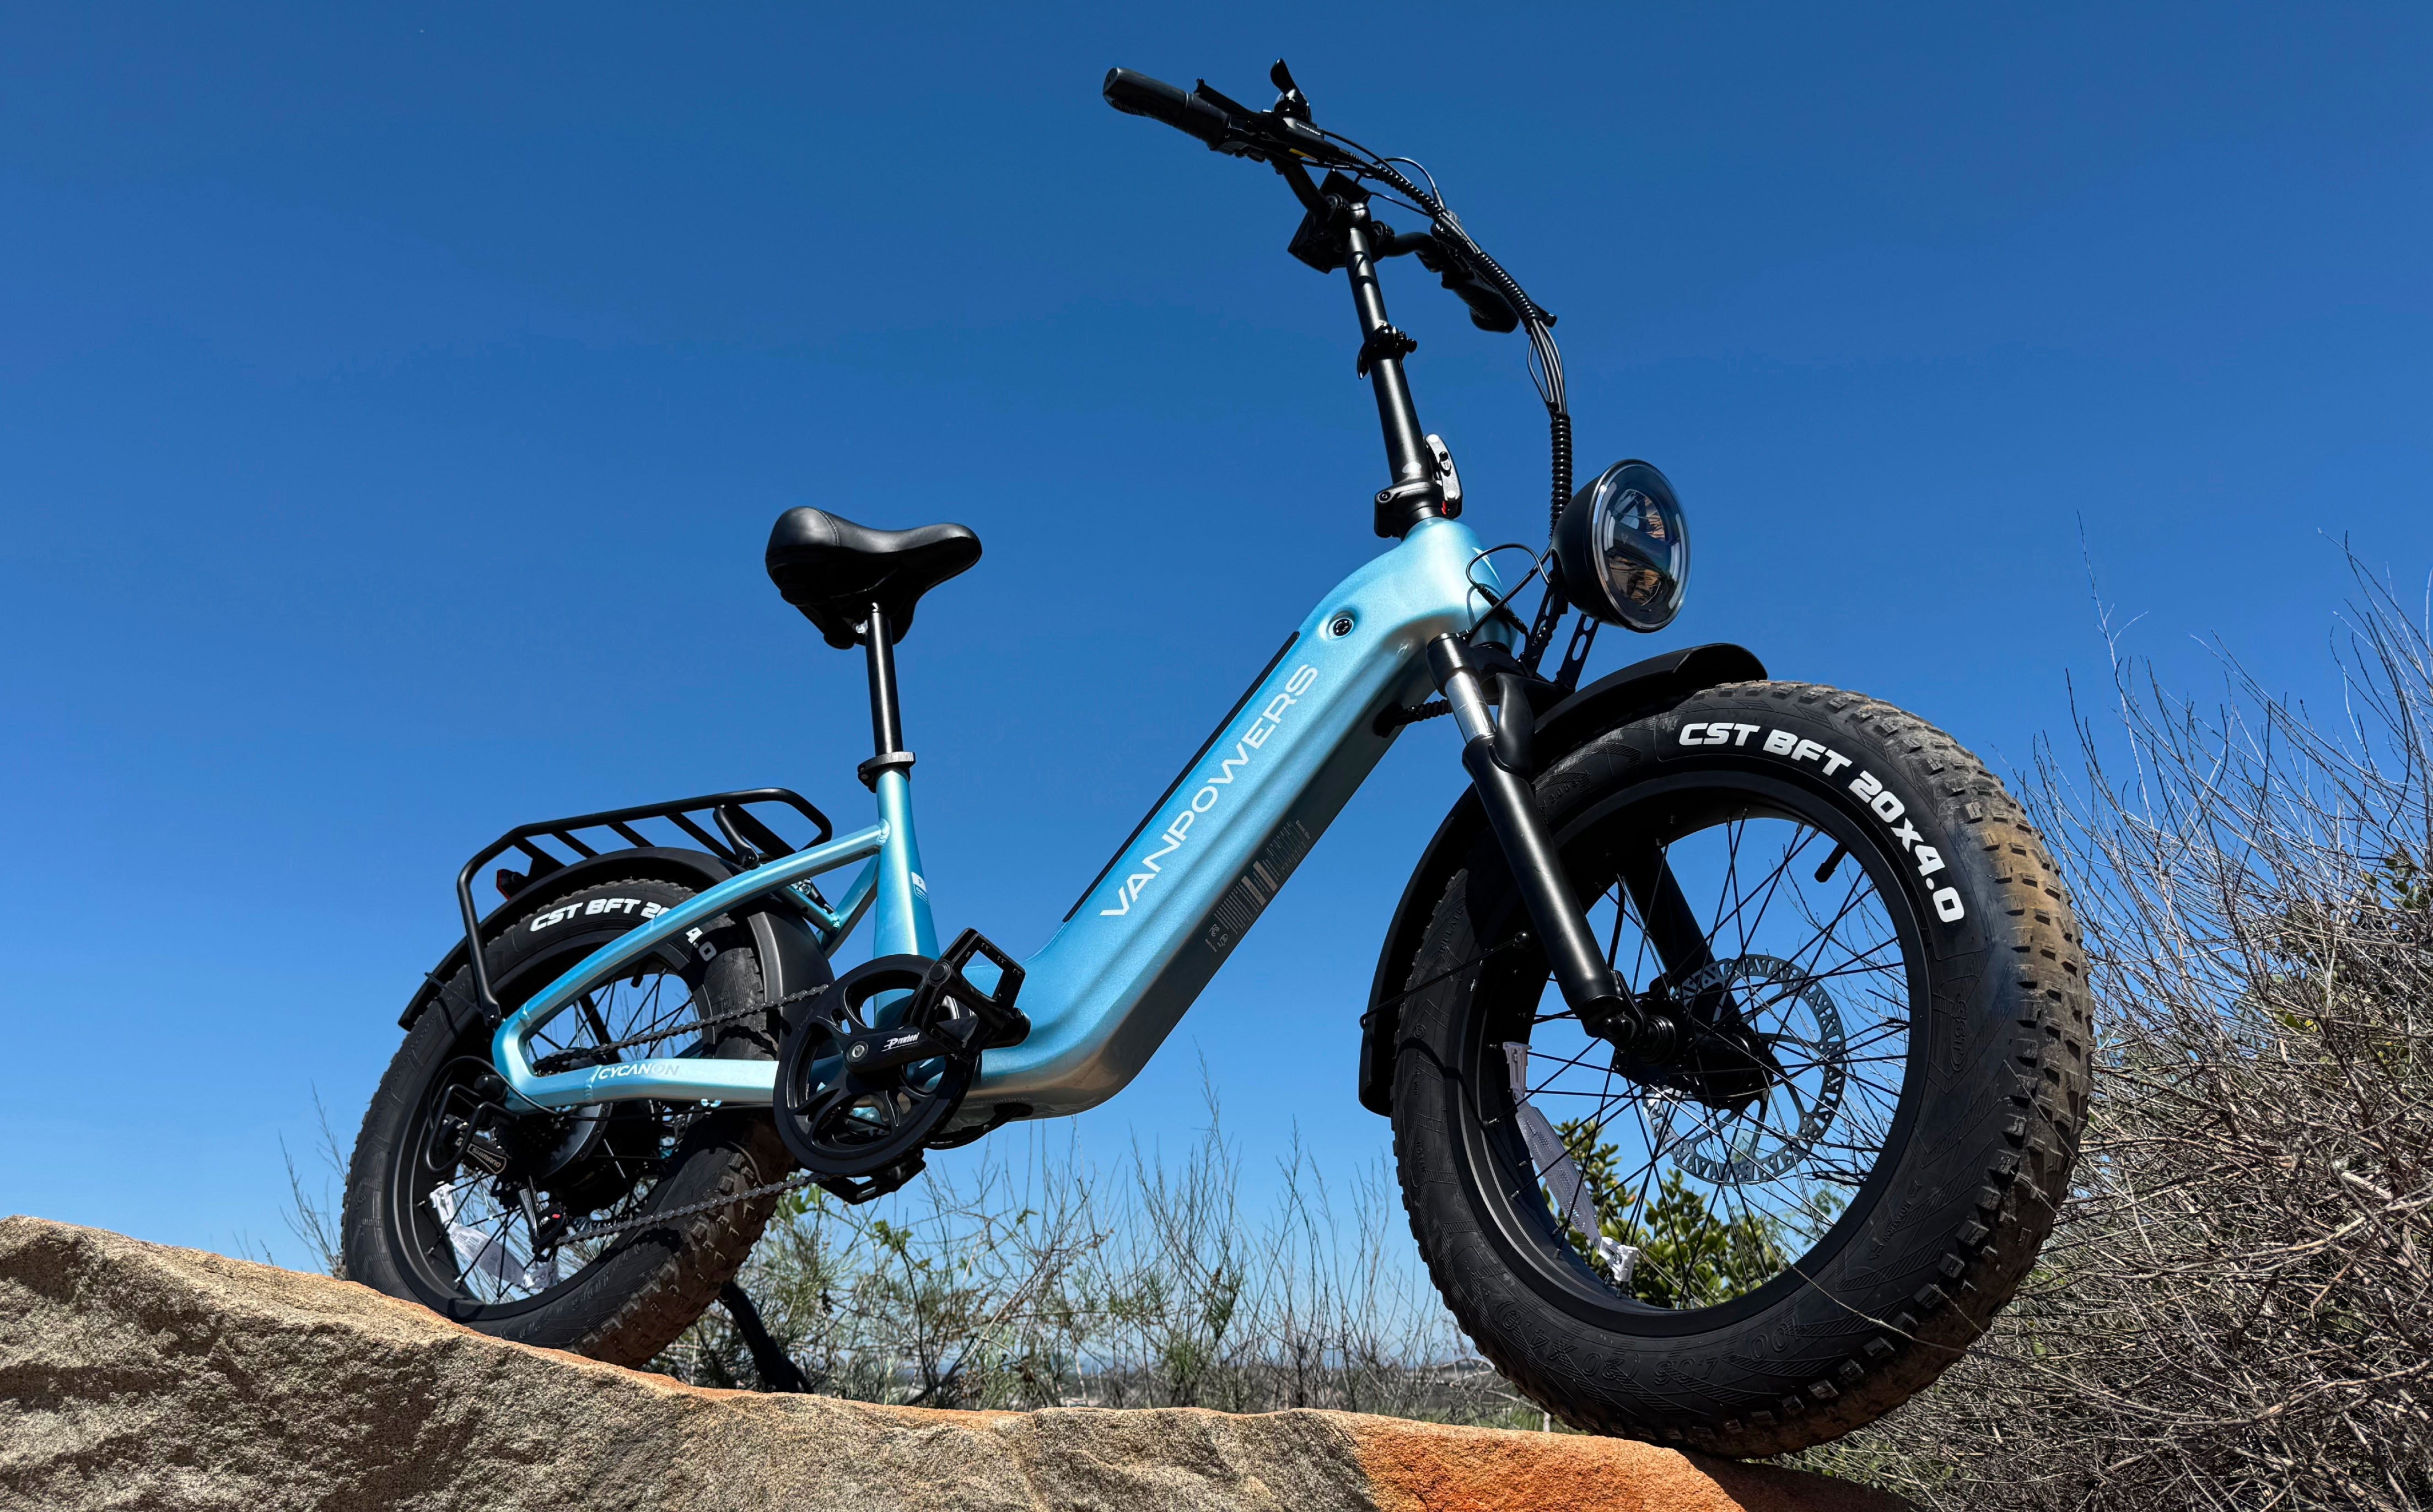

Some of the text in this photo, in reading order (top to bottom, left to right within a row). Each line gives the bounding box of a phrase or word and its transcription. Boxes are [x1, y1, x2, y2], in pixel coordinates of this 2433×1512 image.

[1679, 723, 1761, 746] CST
[1763, 729, 1852, 776] BFT
[1100, 664, 1318, 916] VANPOWERS
[530, 902, 583, 932] CST
[585, 898, 641, 915] BFT
[599, 1062, 680, 1080] CYCANON
[471, 1148, 501, 1167] SHIMANO
